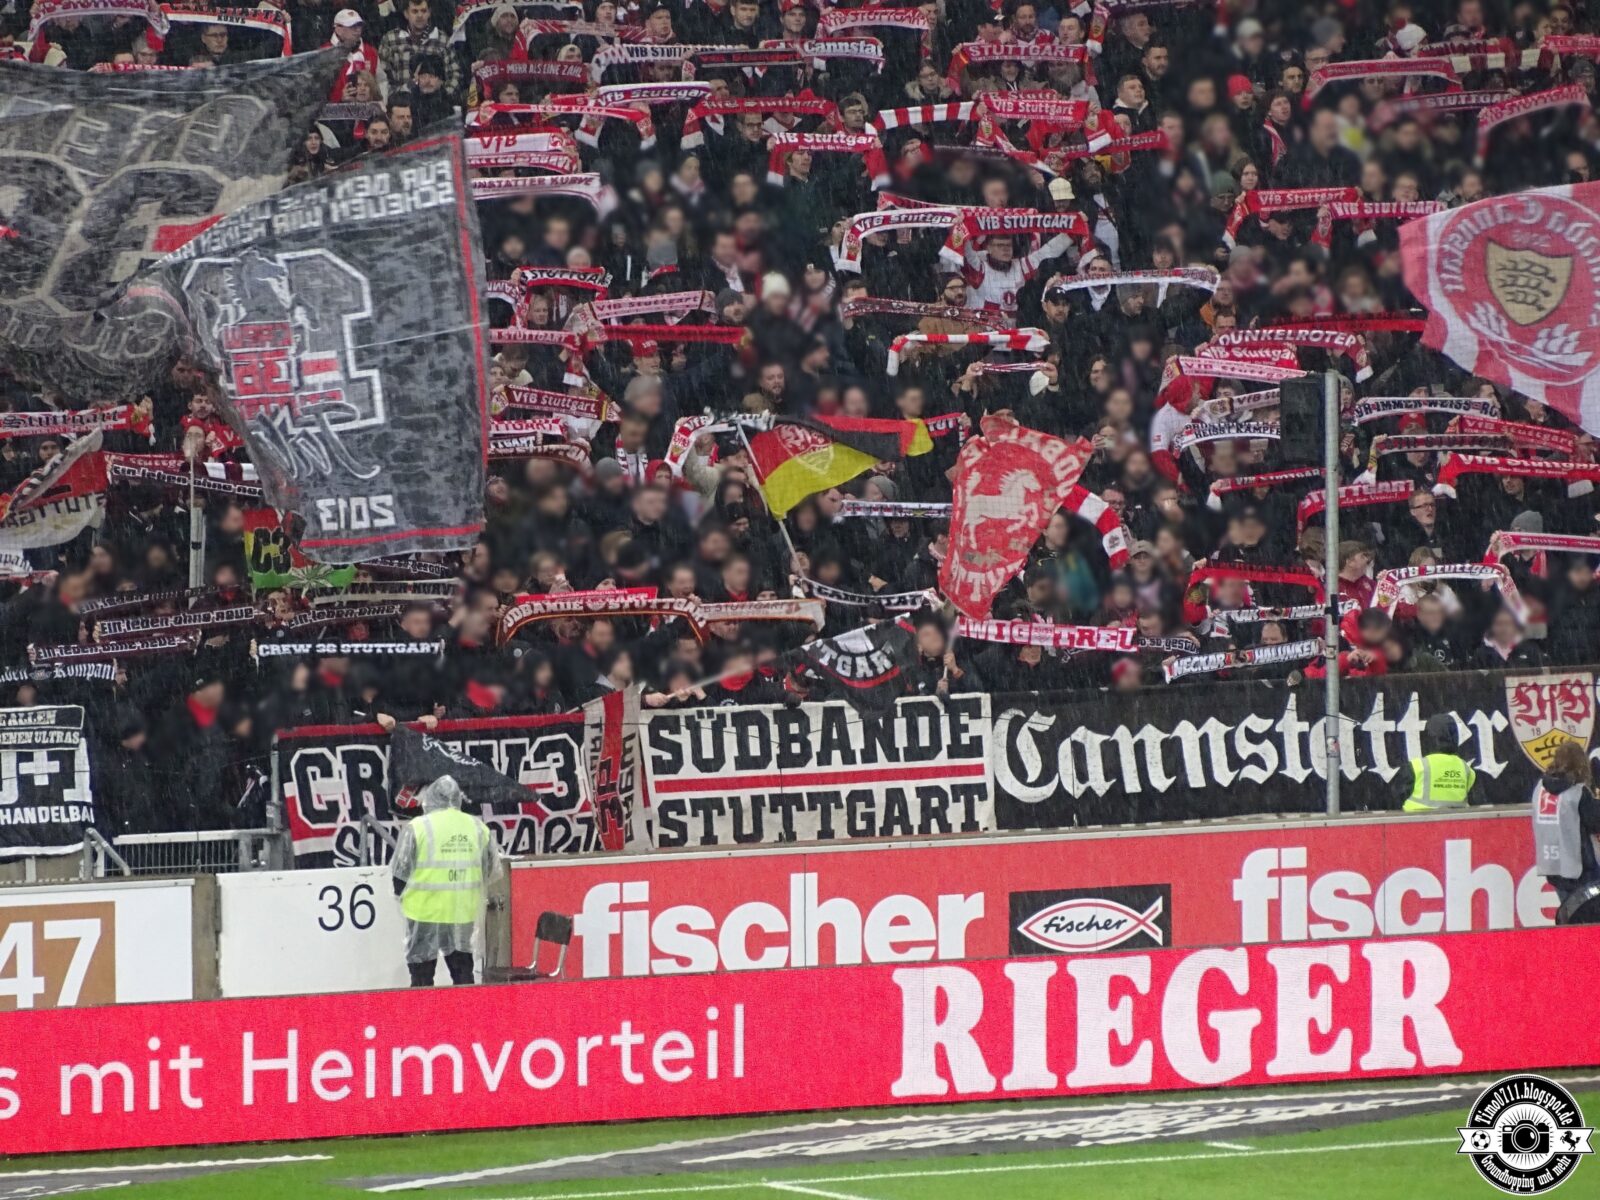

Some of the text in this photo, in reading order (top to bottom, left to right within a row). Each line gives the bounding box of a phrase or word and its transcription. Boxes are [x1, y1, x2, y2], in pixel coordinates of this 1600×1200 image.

[969, 44, 1075, 57] STUTTGART
[479, 136, 517, 153] VfB
[803, 132, 874, 146] Stuttgar
[889, 213, 954, 225] Stuttga
[976, 214, 1077, 230] VfB STUTTGART
[512, 390, 596, 414] VfB Stuttgart
[258, 643, 312, 656] CREW
[341, 642, 440, 654] STUTTGART
[54, 662, 116, 681] Kompani
[8, 710, 57, 726] ALLEN
[34, 731, 80, 745] ULTRAS
[650, 696, 984, 775] SÜDBANDE
[657, 782, 990, 848] STUTTGART
[318, 884, 376, 931] 36
[574, 838, 1561, 978] fischer fischer fische
[891, 940, 1463, 1098] RIEGER
[60, 1037, 204, 1116] mit
[242, 1003, 746, 1106] Heimvorteil
